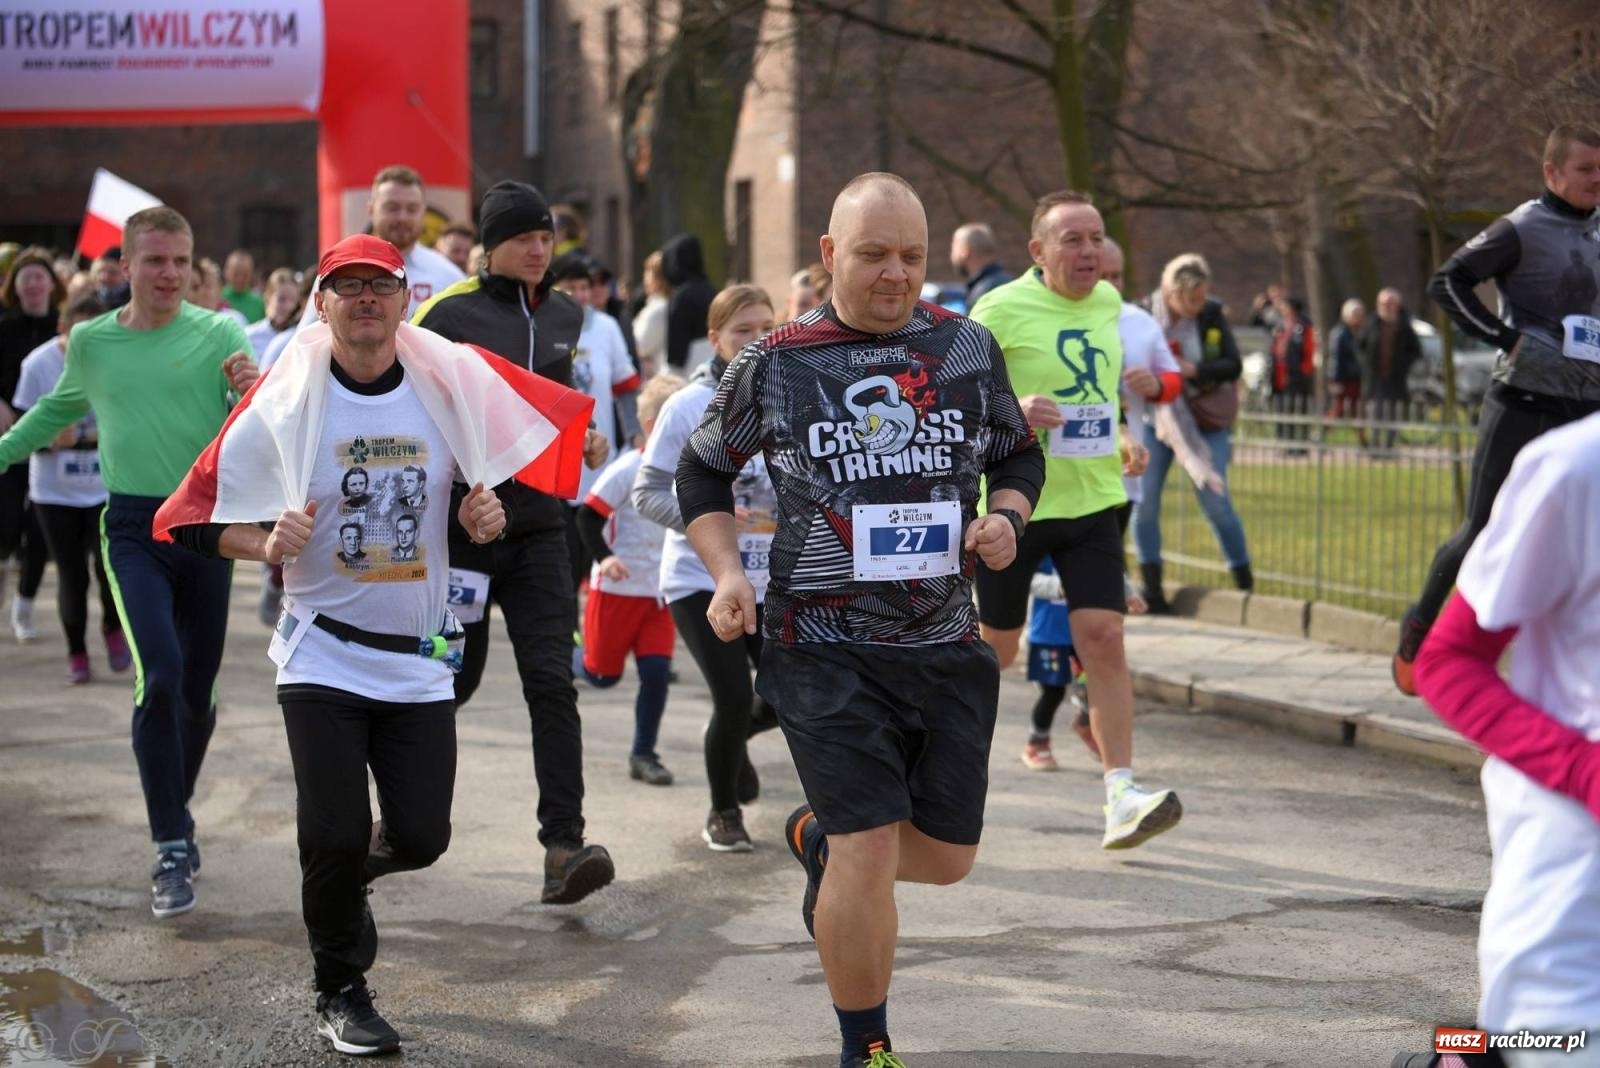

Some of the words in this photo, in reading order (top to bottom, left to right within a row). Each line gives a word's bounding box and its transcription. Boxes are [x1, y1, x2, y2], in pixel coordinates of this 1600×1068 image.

[850, 347, 905, 358] EXTREME
[1078, 420, 1101, 437] 46
[371, 438, 395, 446] TROPEM
[372, 445, 417, 457] WILCZYM
[827, 445, 952, 483] TRENING
[903, 513, 933, 522] WILCZYM
[895, 527, 928, 553] 27
[747, 553, 769, 569] 89
[411, 569, 425, 579] 2024
